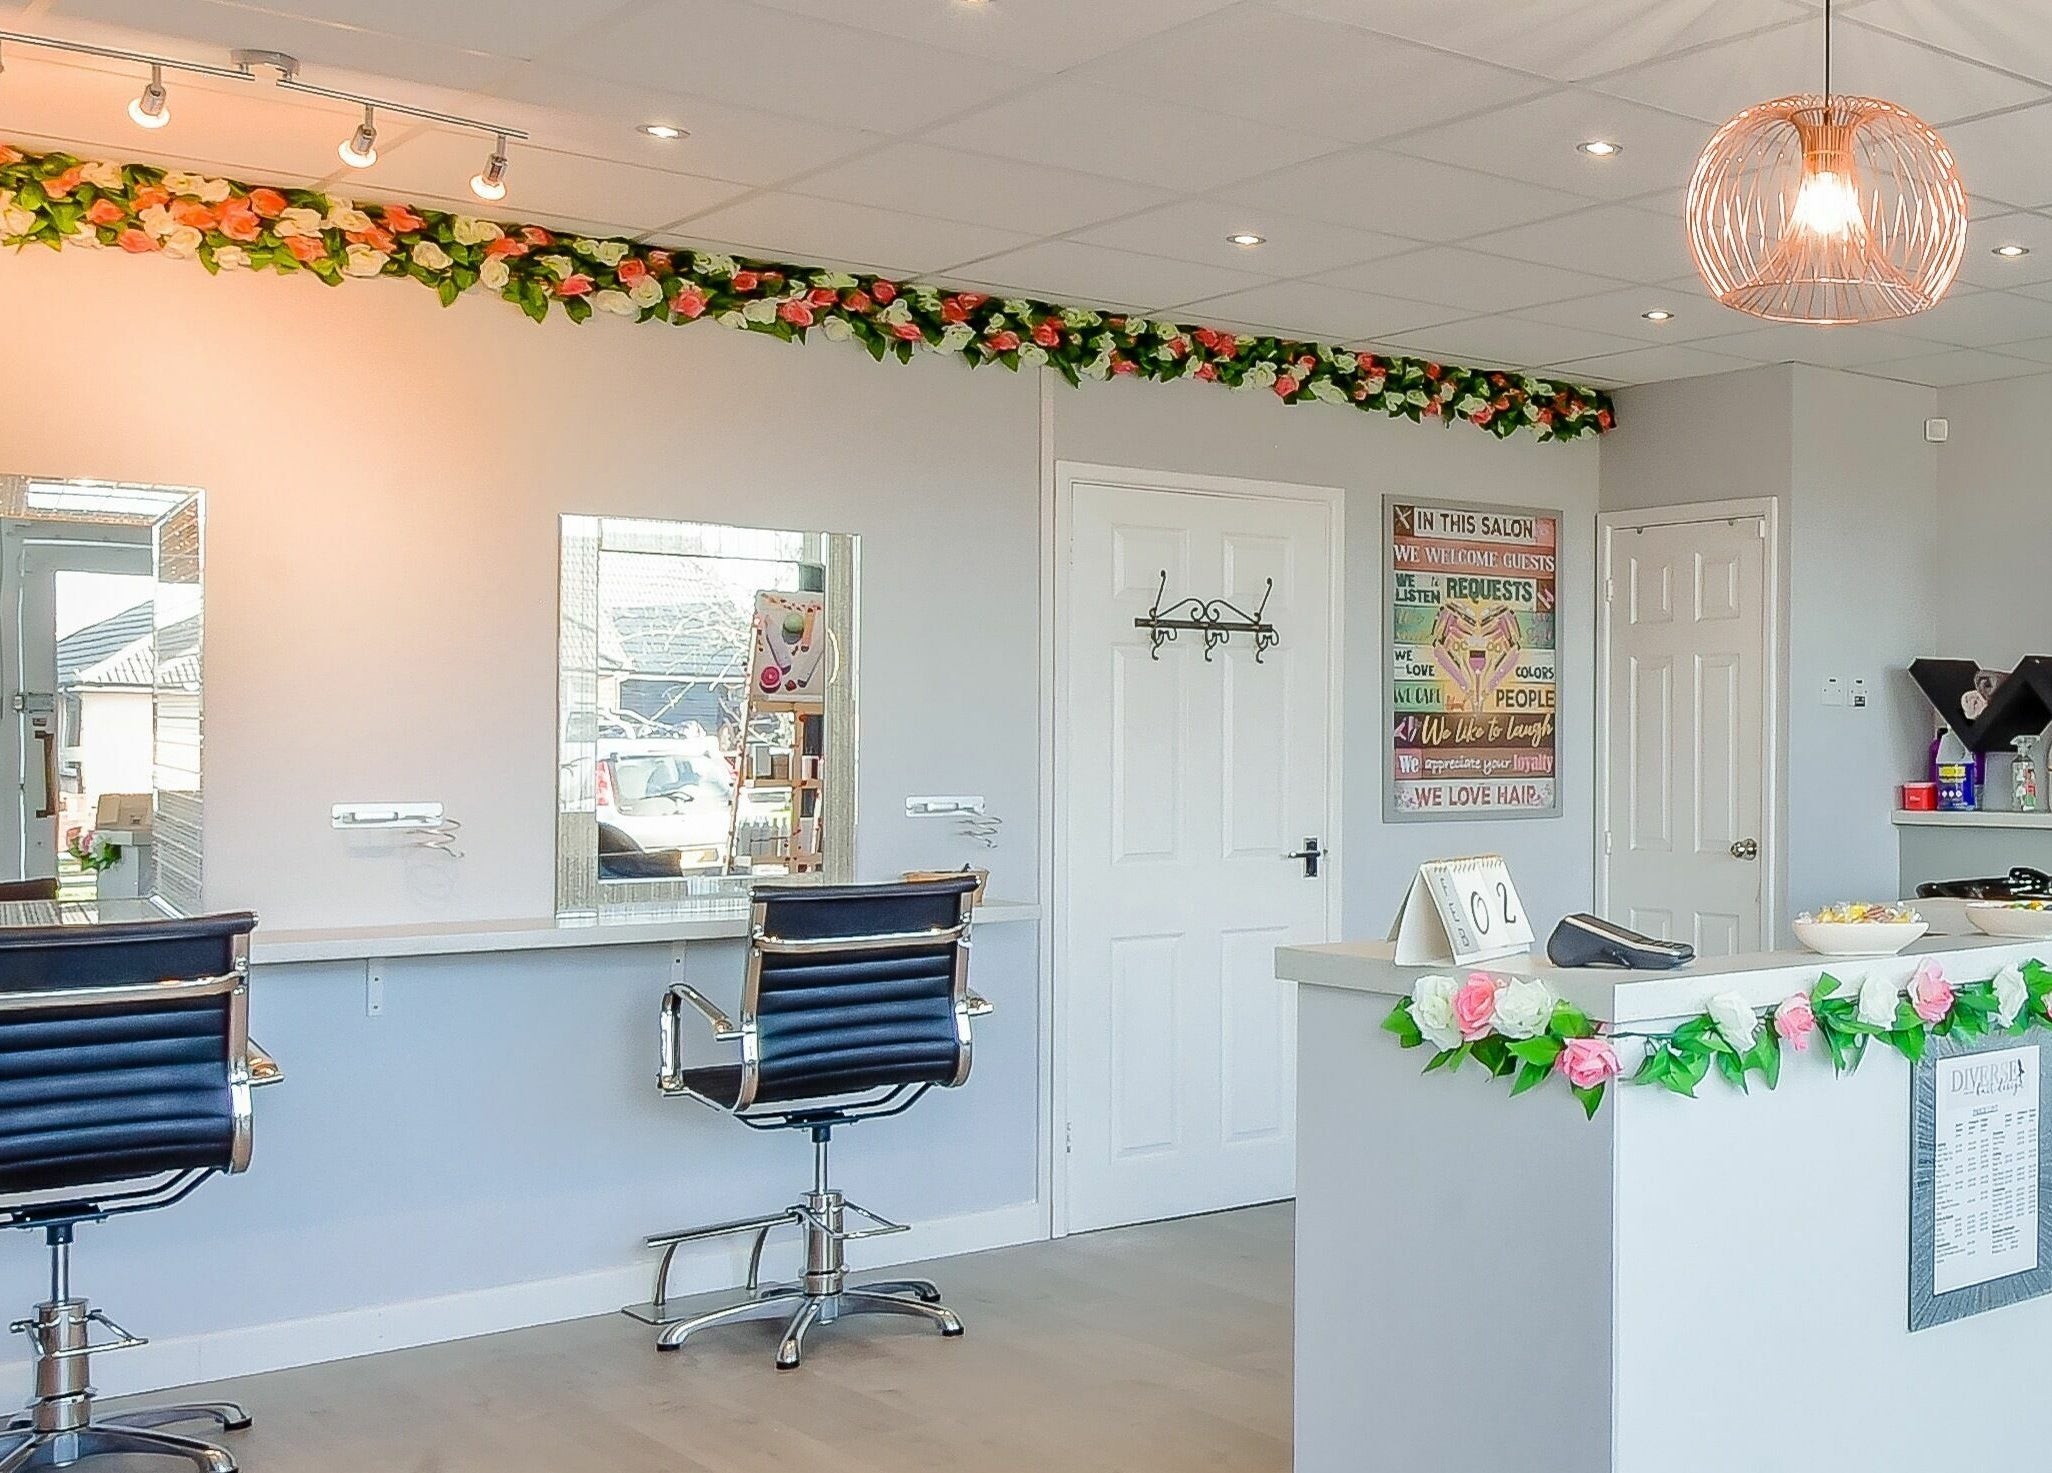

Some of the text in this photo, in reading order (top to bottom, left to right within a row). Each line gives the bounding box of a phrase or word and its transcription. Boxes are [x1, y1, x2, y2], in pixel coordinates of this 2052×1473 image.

[1417, 511, 1533, 539] IN THIS SALON
[1394, 545, 1555, 572] WE WELCOME GUESTS
[1396, 573, 1415, 587] WE
[1396, 588, 1441, 604] LISTEN
[1446, 577, 1533, 604] REQUESTS
[1395, 650, 1413, 662] WE
[1406, 664, 1554, 680] LOVE COLORS
[1496, 689, 1555, 708] PEOPLE
[1421, 714, 1452, 746] We
[1454, 716, 1486, 744] like
[1487, 716, 1503, 742] to
[1398, 753, 1554, 776] We appreciate your loyalty
[1414, 785, 1536, 808] WE LOVE HAIR
[1470, 881, 1517, 936] 02
[1951, 1060, 2018, 1093] DIVERSE
